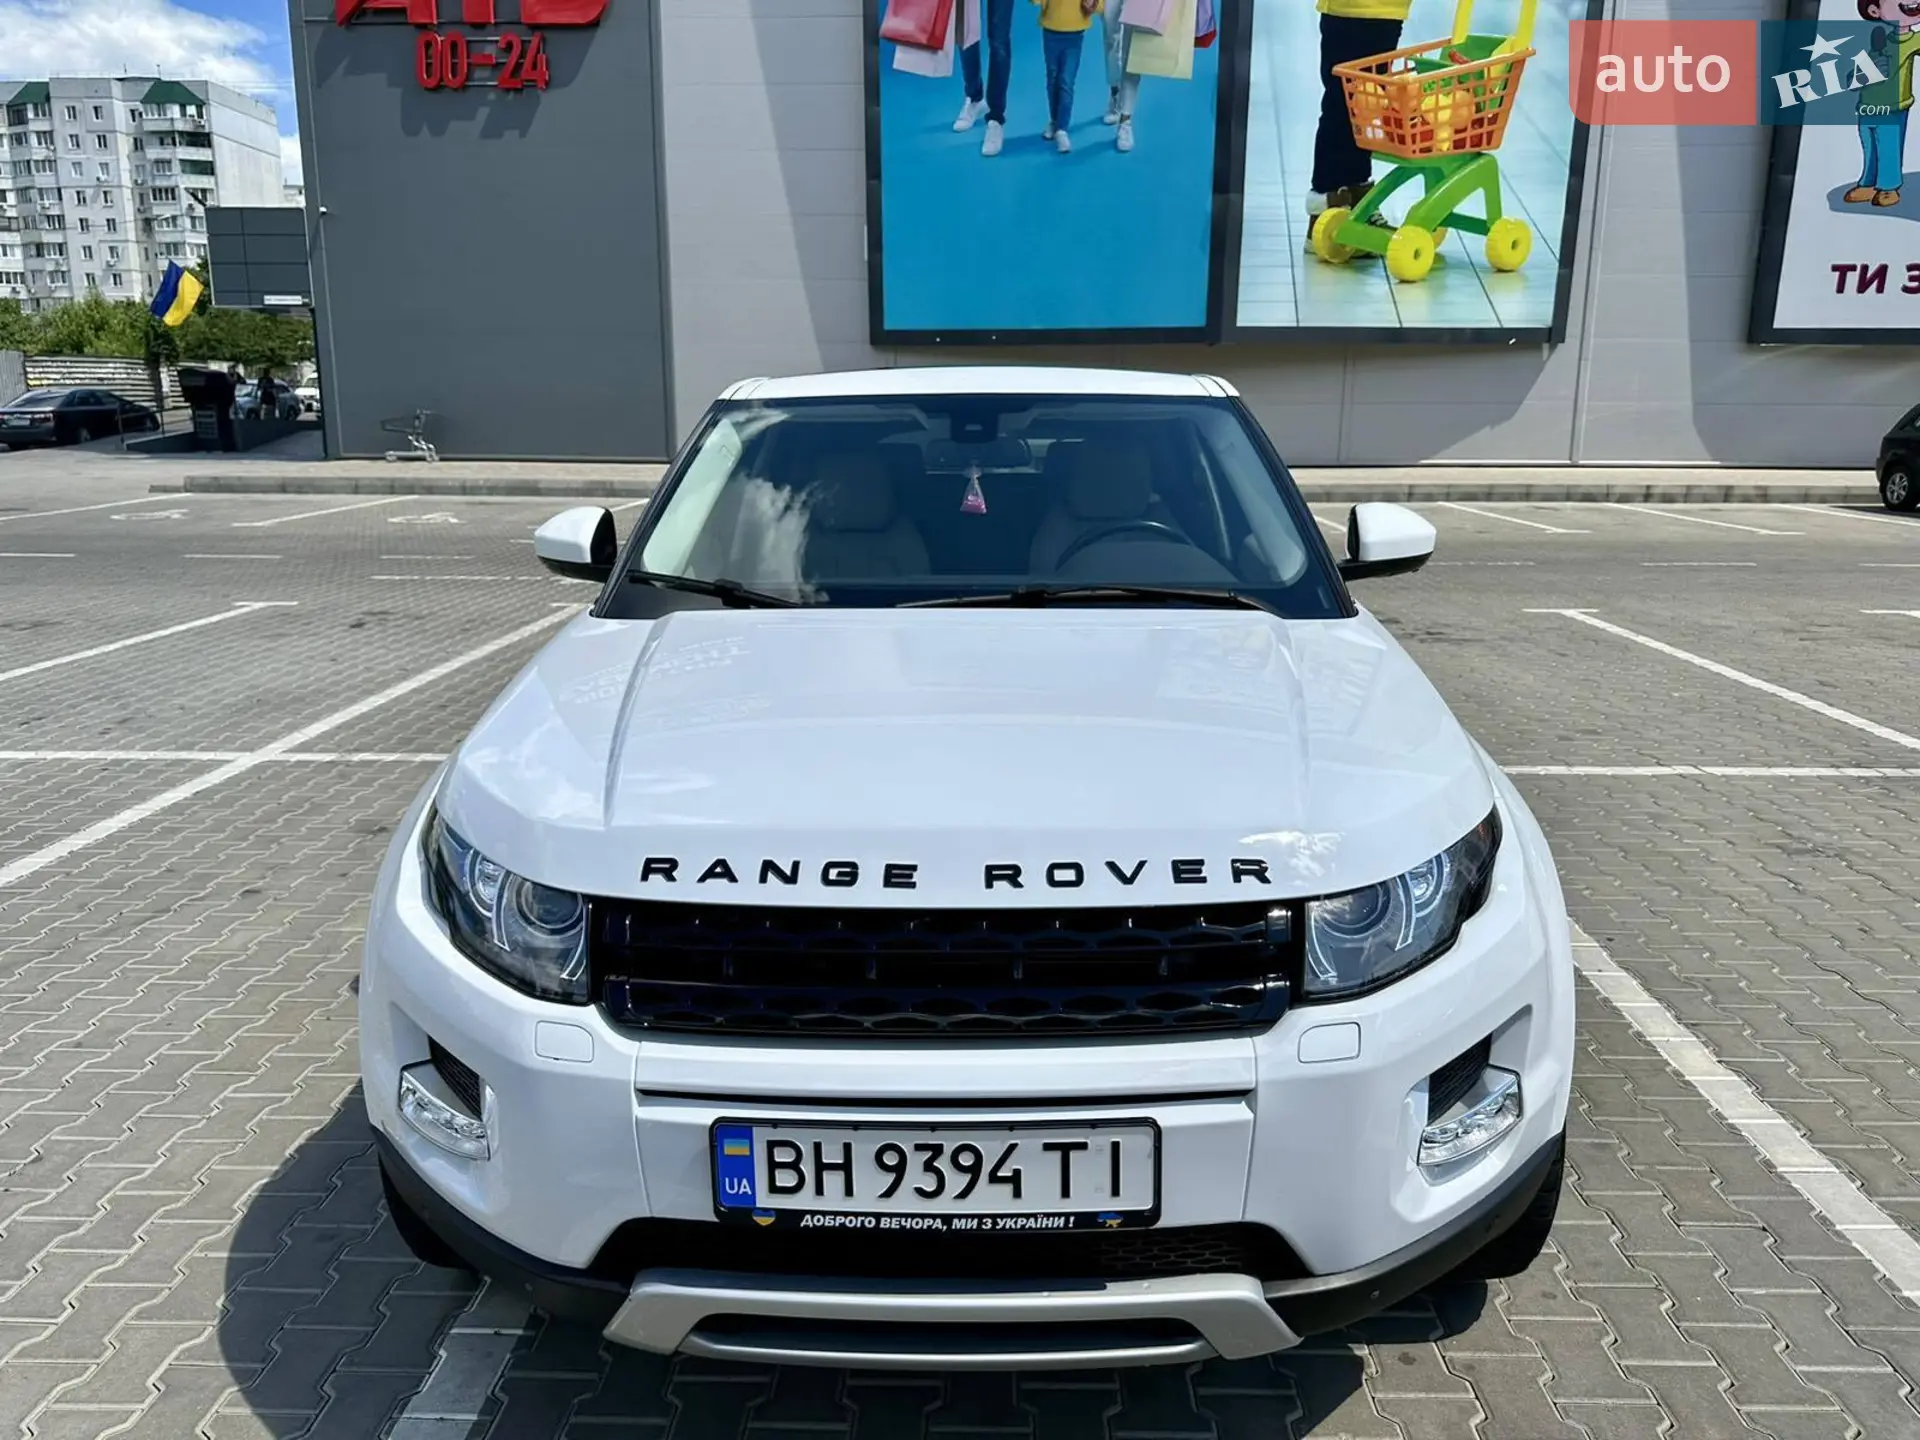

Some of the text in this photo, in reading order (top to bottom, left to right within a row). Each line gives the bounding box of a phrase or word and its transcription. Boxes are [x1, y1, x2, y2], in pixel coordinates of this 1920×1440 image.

[416, 31, 548, 90] 00-24
[1831, 263, 1889, 294] ТИ
[640, 857, 1272, 889] RANGE ROVER
[766, 1139, 854, 1197] BH
[874, 1141, 1022, 1200] 9394
[725, 1177, 752, 1195] UA
[800, 1214, 876, 1228] ДОБРОГО
[879, 1216, 947, 1231] ВЕЧОРА,
[952, 1218, 979, 1230] МИ
[995, 1214, 1066, 1230] УКРАЇНИ
